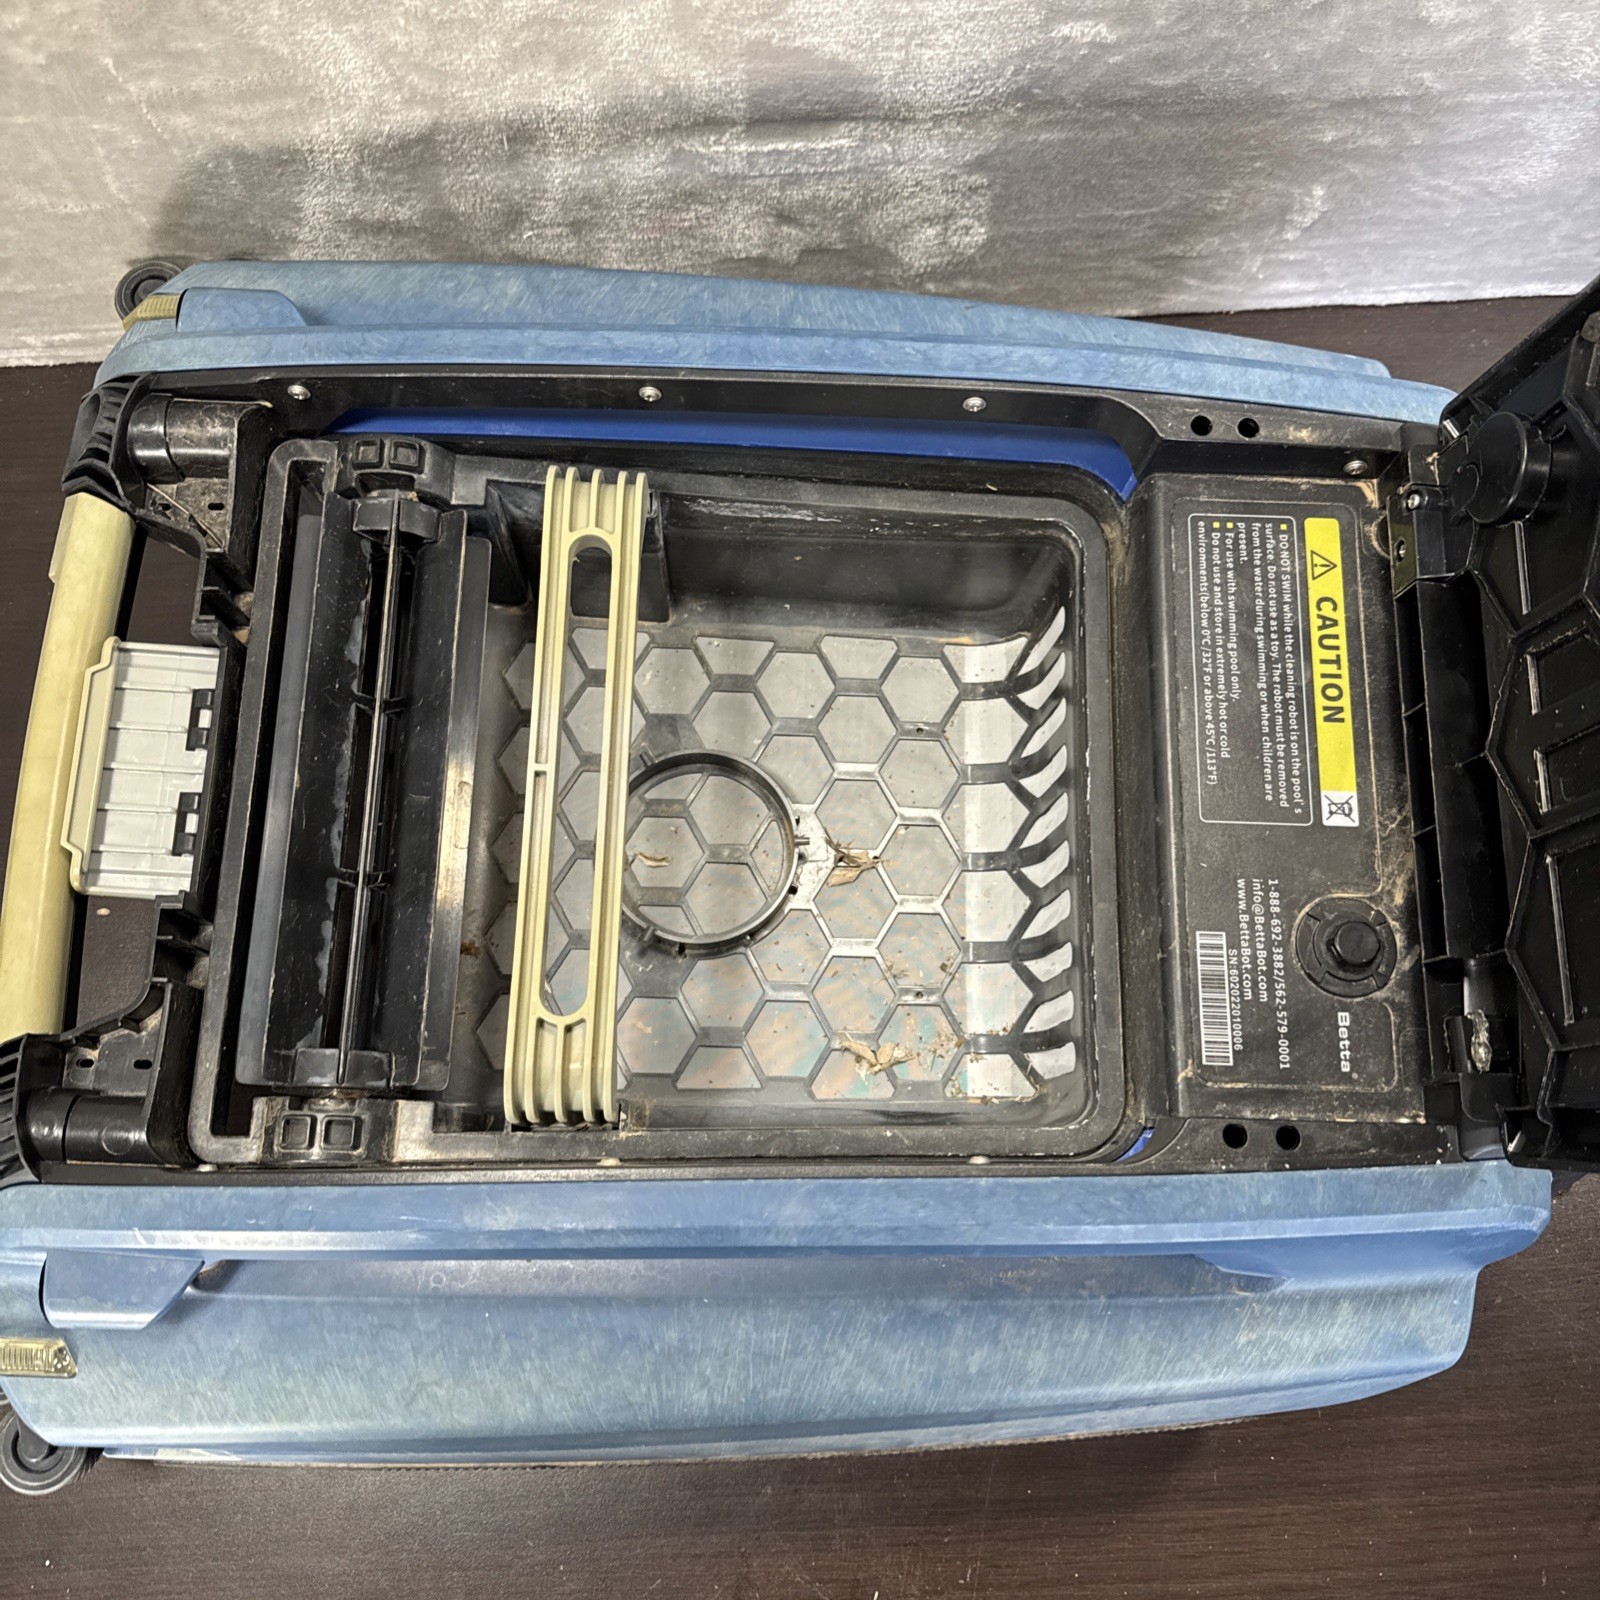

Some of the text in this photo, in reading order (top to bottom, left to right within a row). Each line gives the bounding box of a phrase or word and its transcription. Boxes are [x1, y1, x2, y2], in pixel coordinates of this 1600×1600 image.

[1236, 522, 1248, 564] present.
[1264, 523, 1276, 562] surface.
[1278, 534, 1288, 548] DO
[1266, 565, 1276, 578] Do
[1280, 551, 1289, 571] NOT
[1267, 581, 1277, 597] not
[1281, 574, 1291, 601] SWIM
[1224, 532, 1241, 701] For use with swimming pool only.
[1268, 600, 1276, 617] use
[1282, 604, 1293, 631] while
[1269, 619, 1277, 630] as
[1211, 532, 1230, 757] Do not use and store in extremely hot or cold
[1268, 641, 1280, 660] toy.
[1284, 634, 1294, 651] the
[1251, 523, 1273, 801] from the water during swimming or when children are
[1271, 663, 1281, 682] The
[1315, 596, 1345, 723] CAUTION
[1203, 675, 1211, 686] or
[1285, 653, 1297, 698] cleaning
[1203, 688, 1215, 720] above
[1272, 684, 1283, 713] robot
[1274, 715, 1284, 741] must
[1287, 700, 1298, 729] robot
[1275, 744, 1286, 757] be
[1290, 742, 1297, 755] on
[1290, 758, 1301, 775] the
[1276, 759, 1289, 807] removed
[1237, 878, 1252, 999] www.BettaBot.com
[1250, 878, 1269, 1001] info@BettaBot.com
[1267, 878, 1290, 1069] 1-888-692-3882/562-579-0001
[1227, 948, 1243, 1050] SN:602022010006
[1337, 1011, 1352, 1072] Betta
